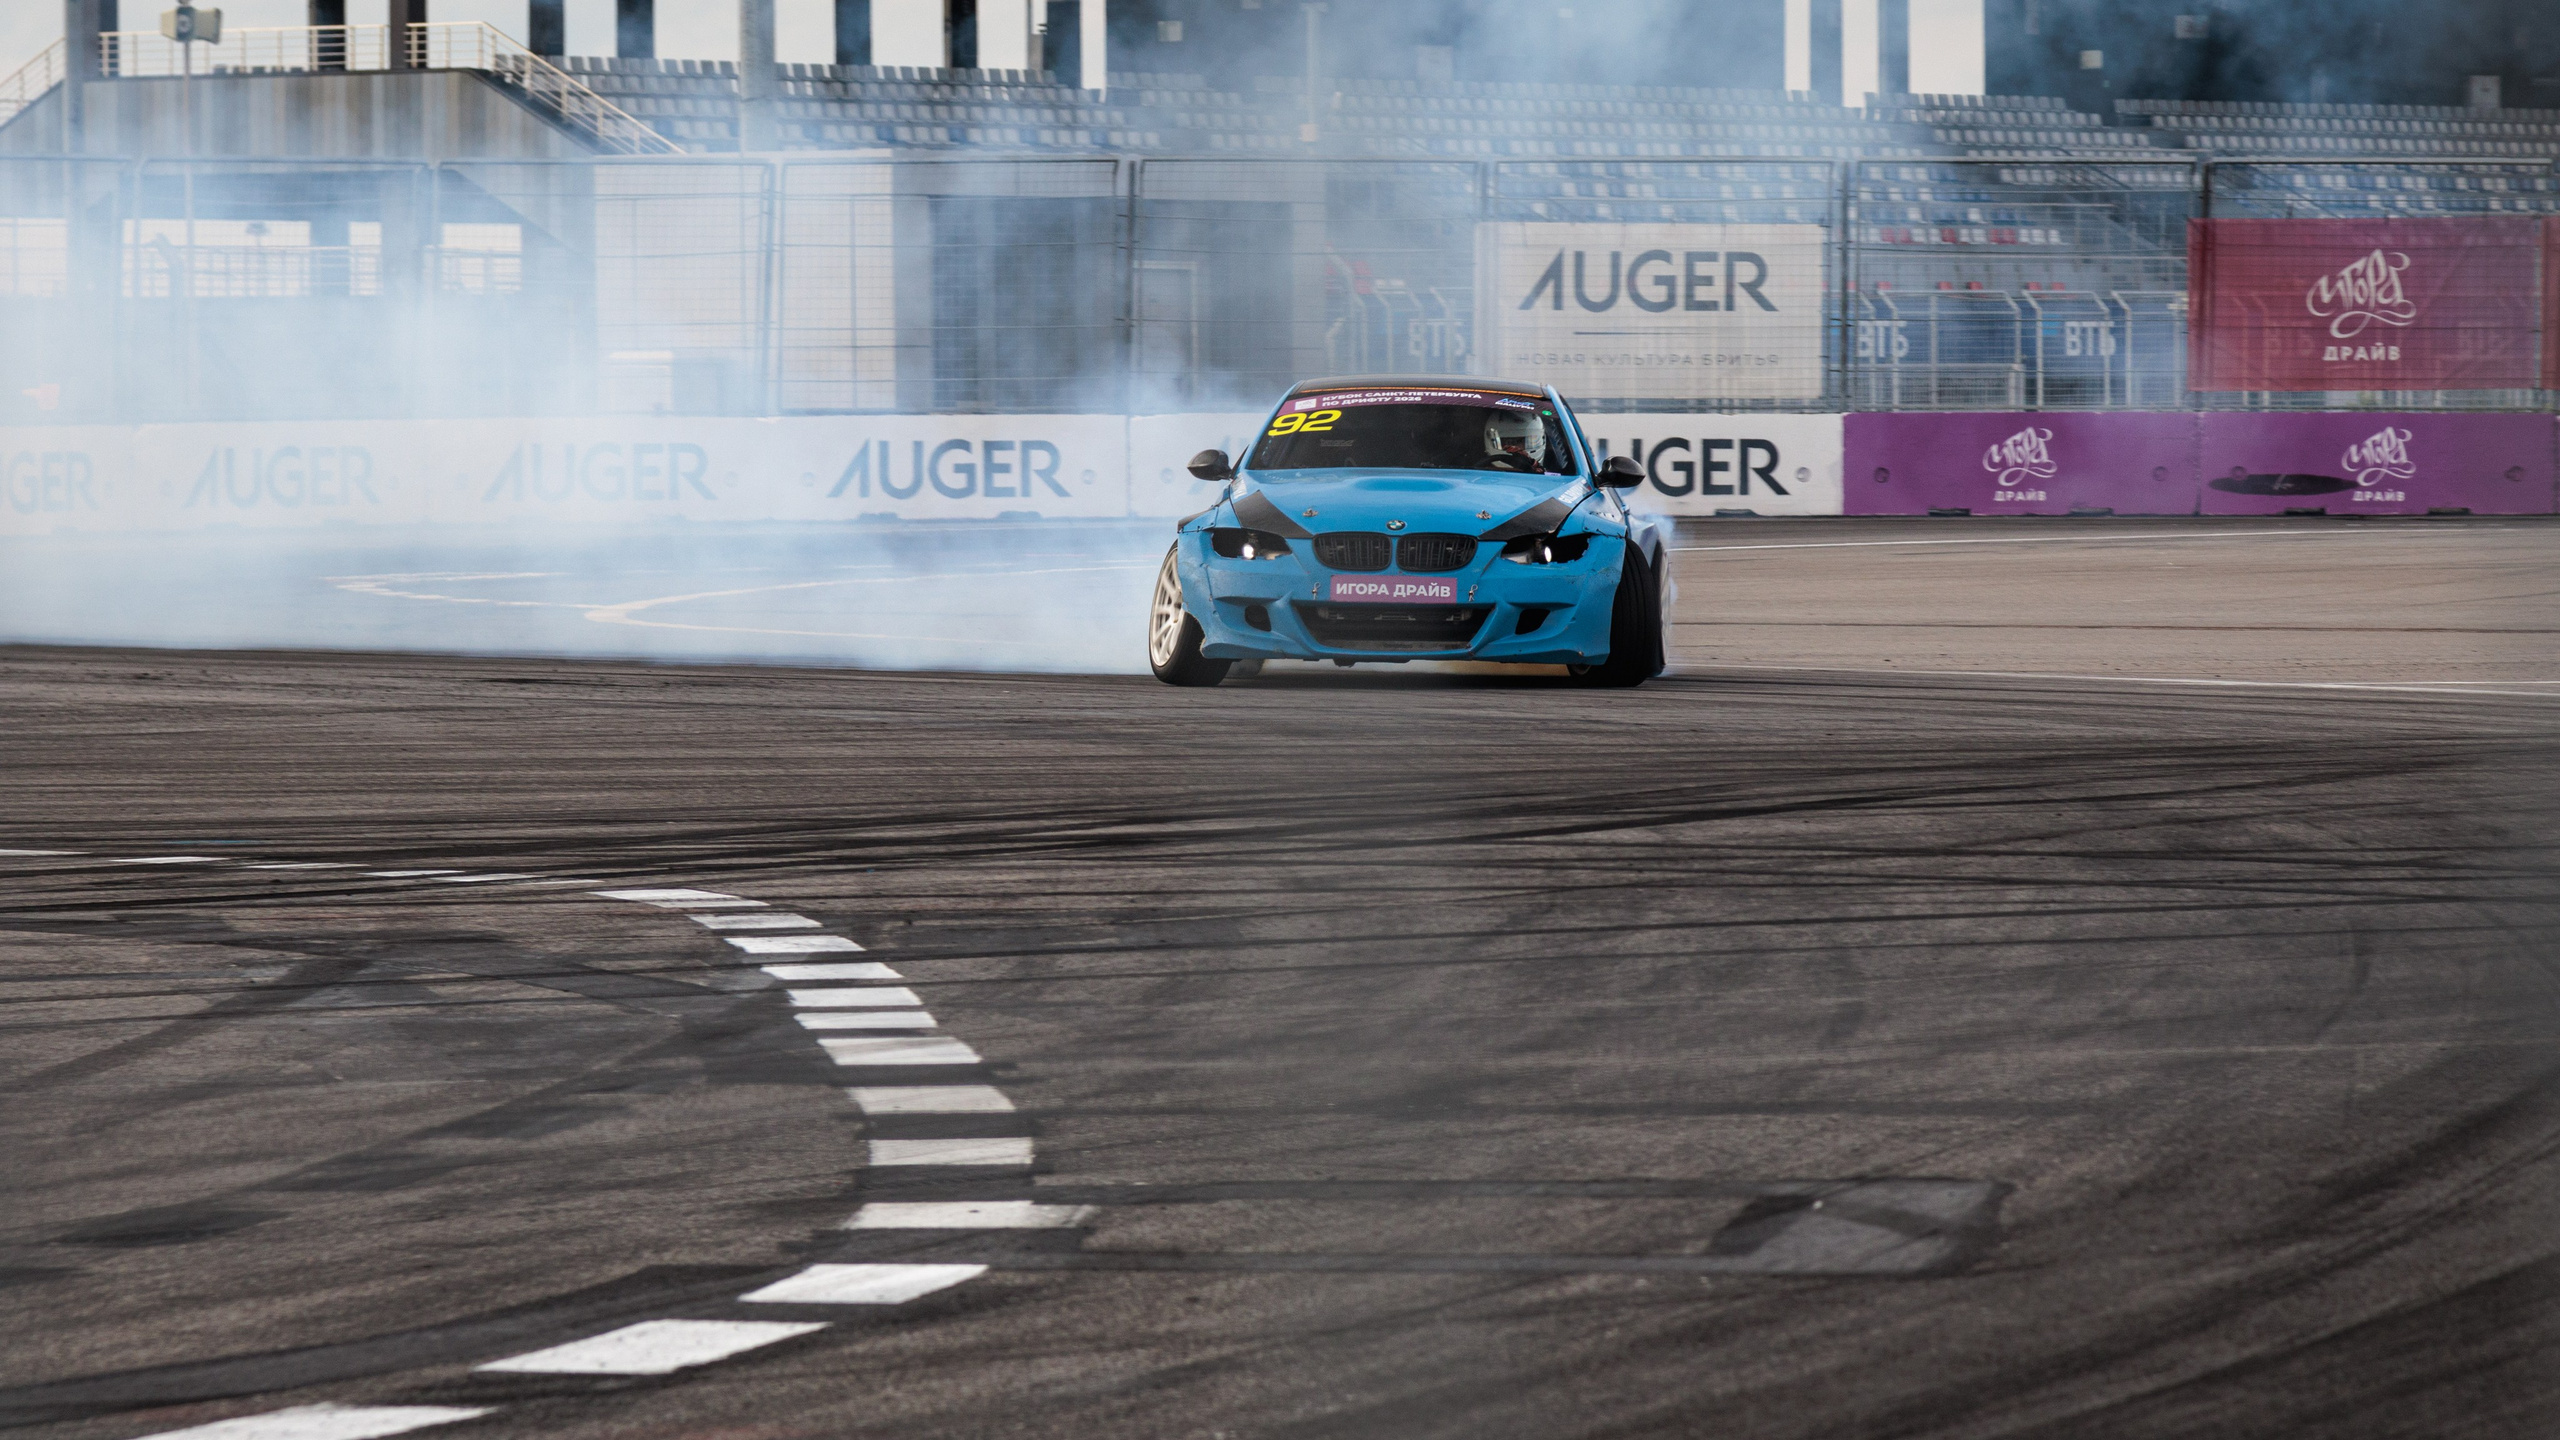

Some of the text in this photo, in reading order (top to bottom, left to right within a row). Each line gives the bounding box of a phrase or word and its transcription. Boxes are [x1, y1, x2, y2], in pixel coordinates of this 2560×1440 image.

[1517, 247, 1780, 313] AUGER
[1857, 320, 1909, 358] ВТБ
[2065, 321, 2116, 357] ВТБ
[2322, 342, 2401, 361] ДРАЙВ
[1517, 353, 1780, 366] НОВАЯ КУЛЬТУРА БРИТЬЯ
[1322, 391, 1482, 402] КУБОК САНКТ-ПЕТЕРБУРГА
[1342, 397, 1392, 406] ДРИФТУ
[1267, 409, 1342, 437] 92
[0, 448, 101, 515] GER
[182, 444, 380, 508] AUGER
[480, 438, 719, 503] AUGER
[826, 437, 1074, 500] AUGER
[1993, 488, 2047, 502] ДРАЙВ
[2352, 488, 2406, 502] ДРАЙВ
[1336, 582, 1451, 598] ИГОРА ДРАЙВ
